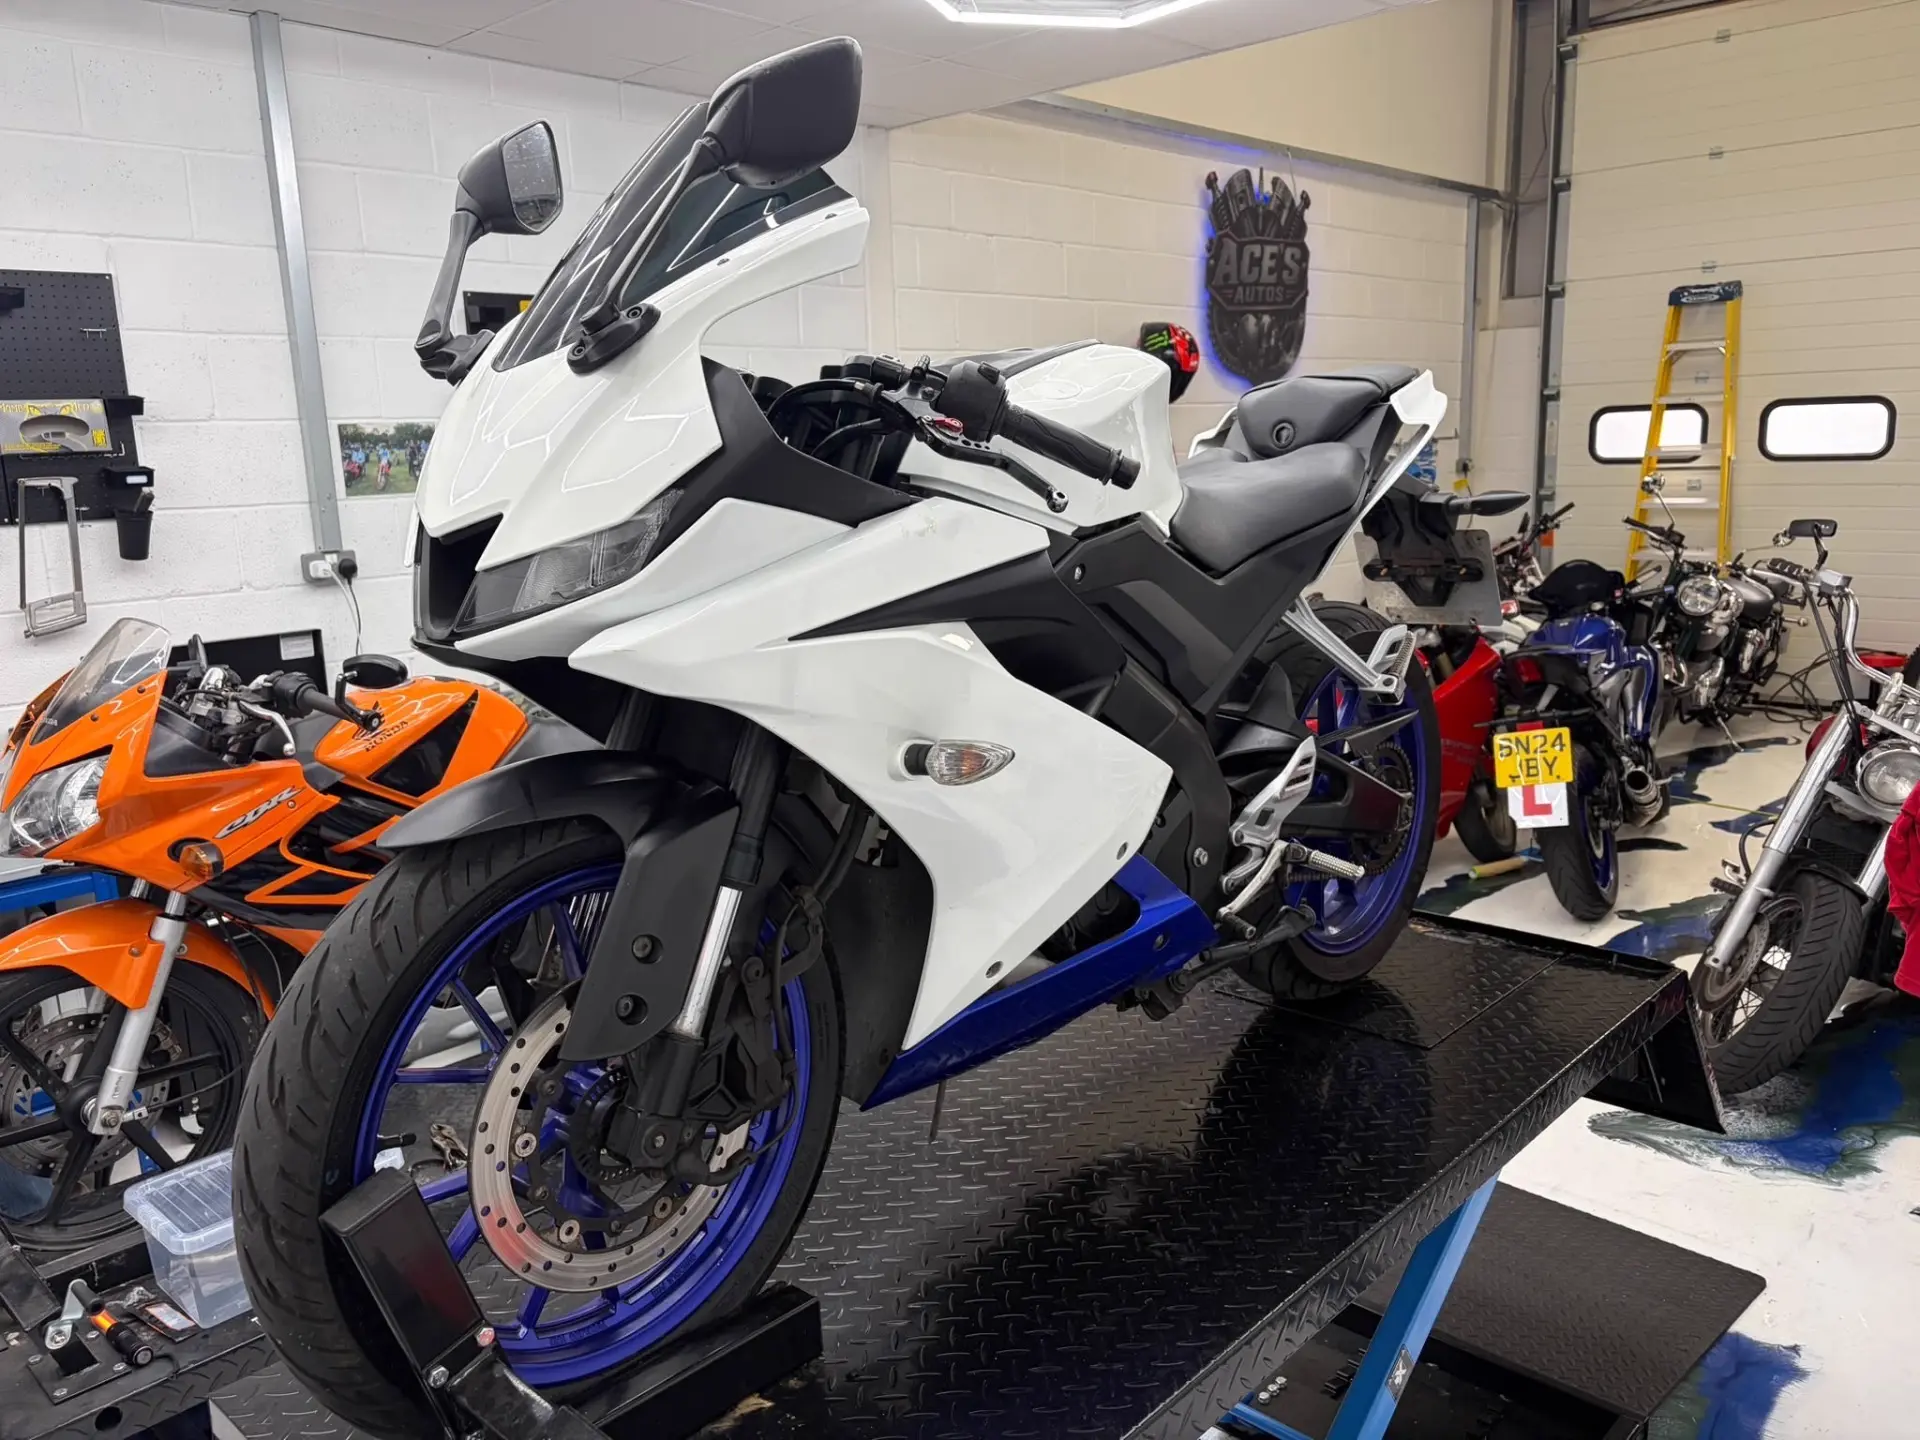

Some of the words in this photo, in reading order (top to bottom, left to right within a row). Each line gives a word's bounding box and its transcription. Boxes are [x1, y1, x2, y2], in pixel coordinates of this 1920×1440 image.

[1211, 238, 1302, 285] ACE'S
[1233, 286, 1284, 304] AUTOS
[213, 785, 304, 840] CBR
